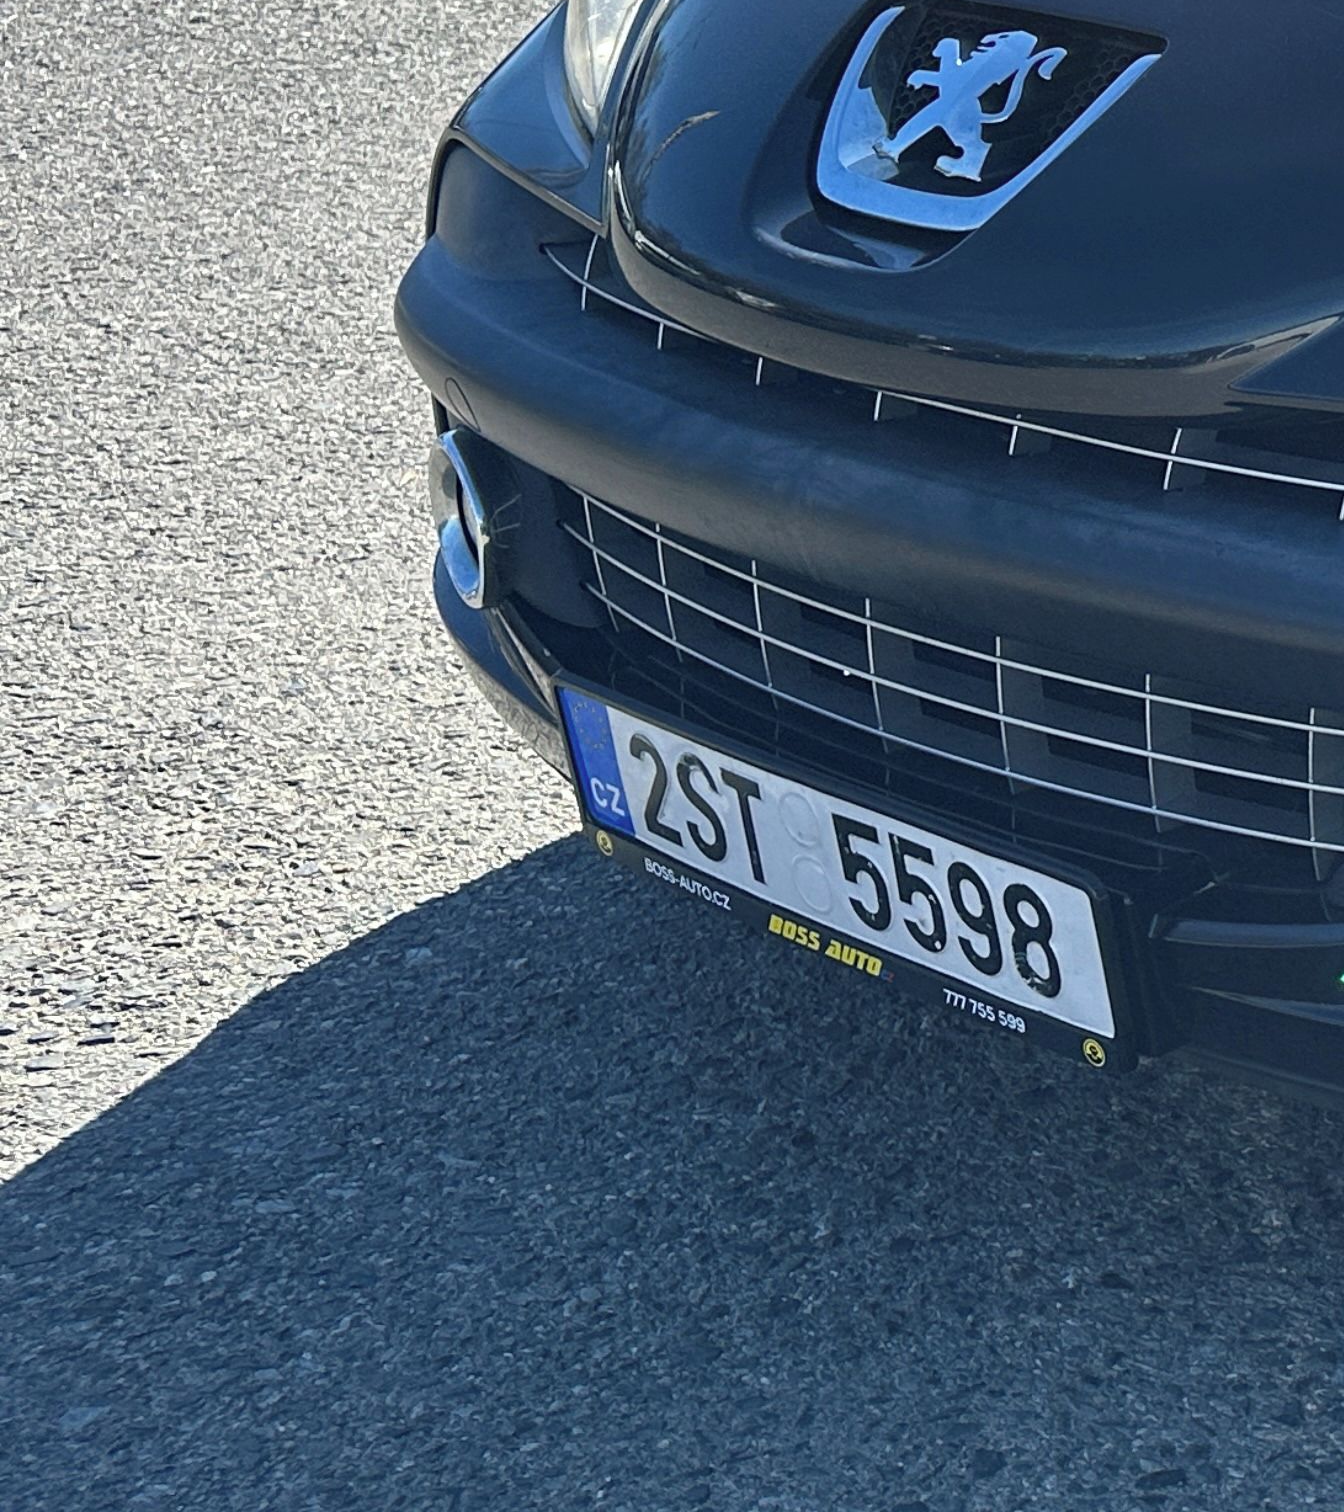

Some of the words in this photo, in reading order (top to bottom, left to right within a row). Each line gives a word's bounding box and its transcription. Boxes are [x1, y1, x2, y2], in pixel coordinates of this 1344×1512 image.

[590, 776, 626, 817] CZ
[629, 732, 768, 886] 2ST
[831, 812, 1062, 999] 5598
[643, 856, 732, 911] BOSS-AUTO.CZ
[768, 913, 821, 951] BOSS
[824, 938, 883, 977] AUTO
[942, 987, 967, 1010] 777
[968, 997, 996, 1022] 755
[998, 1009, 1026, 1034] 599
